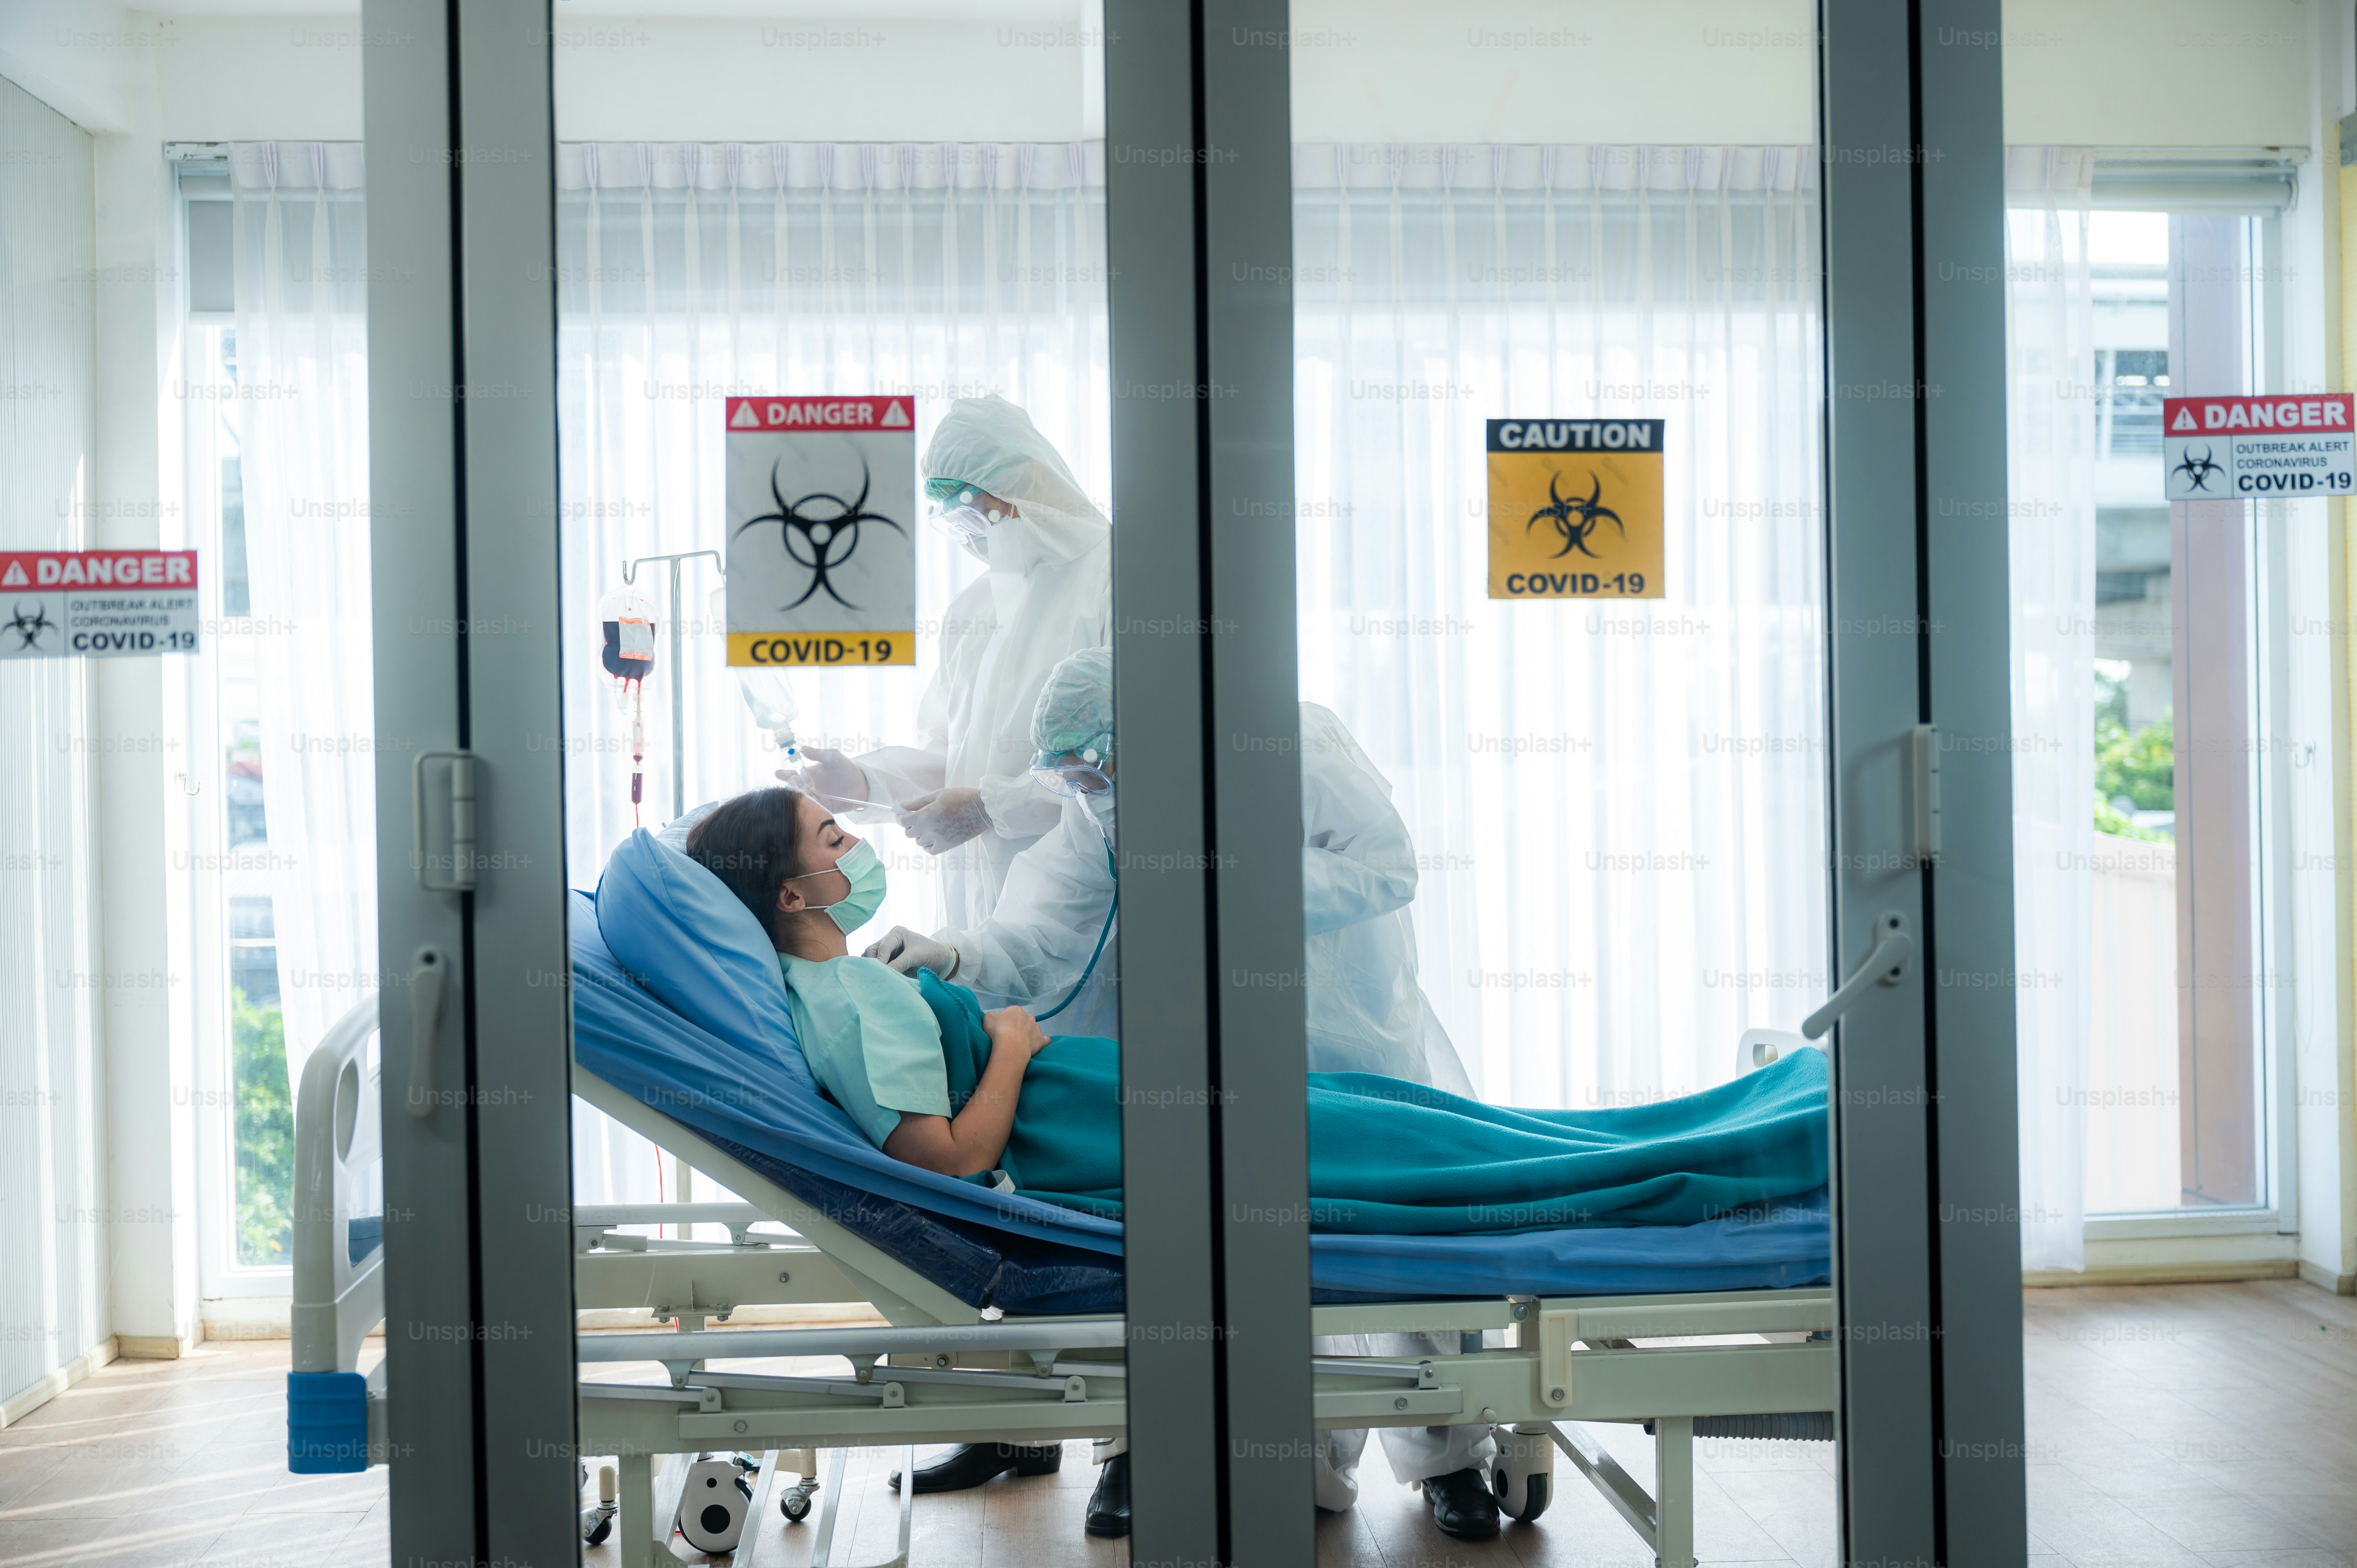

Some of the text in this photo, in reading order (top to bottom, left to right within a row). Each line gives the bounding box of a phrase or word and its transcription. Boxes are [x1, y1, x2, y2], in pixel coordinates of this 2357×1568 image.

[767, 403, 874, 426] DANGER
[2204, 401, 2347, 429] DANGER
[1499, 422, 1651, 449] CAUTION
[2236, 441, 2349, 454] OUTBREAK ALERT
[2237, 457, 2328, 469] CORONAVIRUS
[2239, 472, 2352, 491] COVID-19
[36, 556, 192, 585] DANGER
[1507, 573, 1645, 594] COVID-19
[71, 599, 194, 611] OUTBREAK ALERT
[71, 615, 170, 627] CORONAVIRUS
[73, 632, 195, 650] COVID-19
[750, 639, 892, 664] COVID-19
